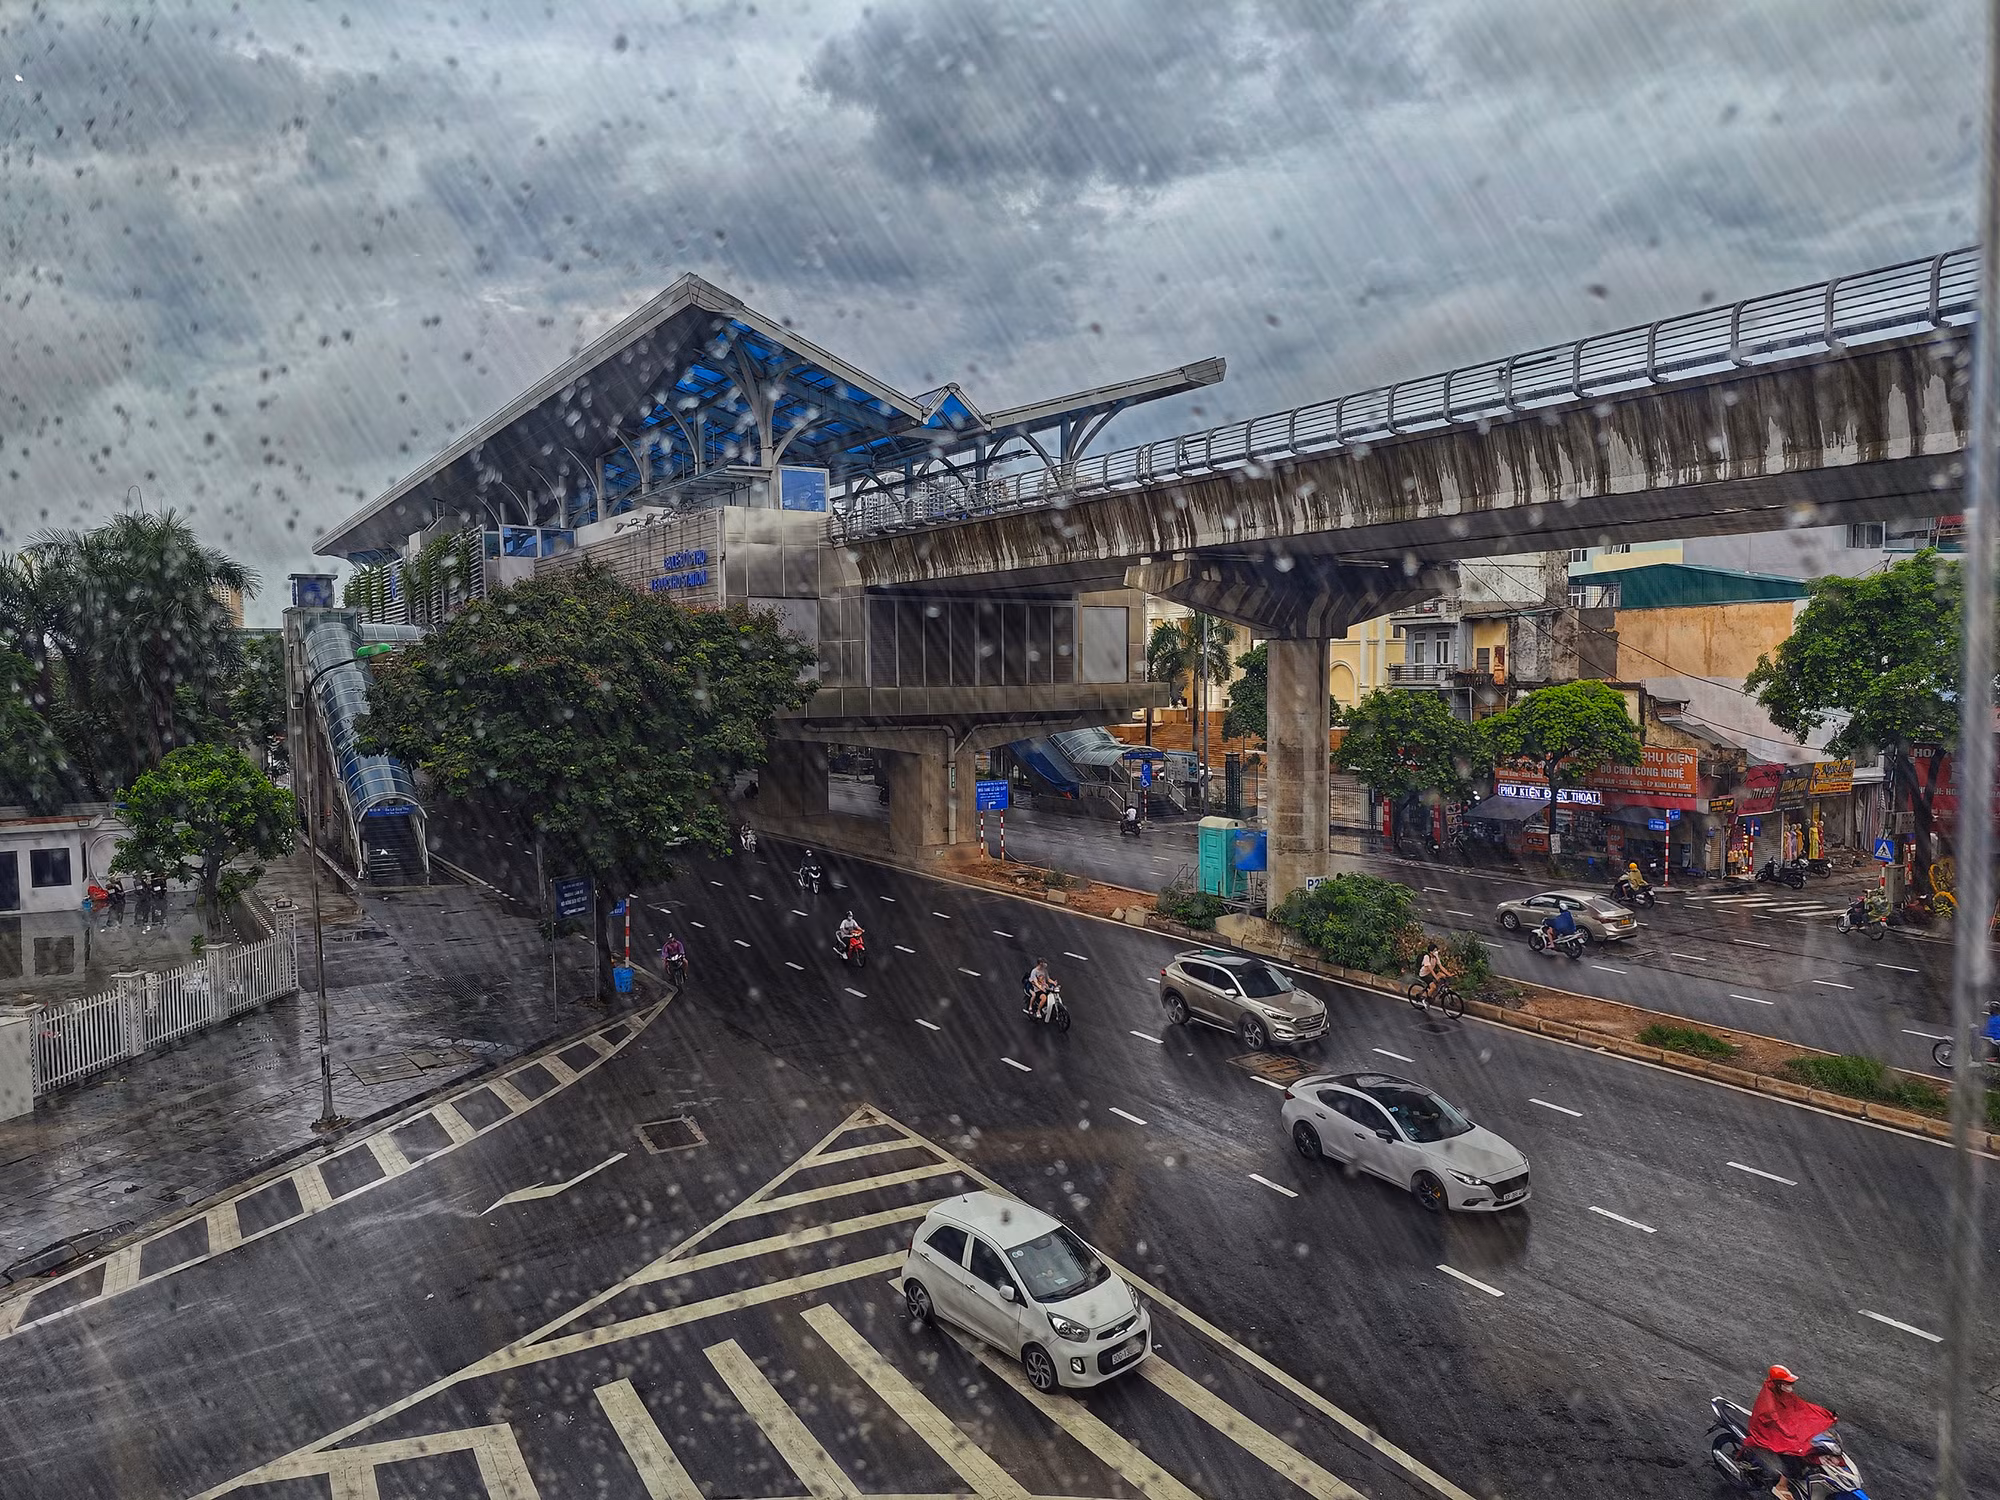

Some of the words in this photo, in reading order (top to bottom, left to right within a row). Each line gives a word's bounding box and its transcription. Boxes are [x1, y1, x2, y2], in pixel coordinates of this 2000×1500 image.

[1642, 751, 1664, 765] PHỤ
[1666, 751, 1694, 766] KIỆN
[1500, 786, 1517, 797] PHỤ
[1519, 787, 1541, 798] KIỆN
[1544, 789, 1568, 801] ĐỆN
[1570, 792, 1597, 803] THOẠI
